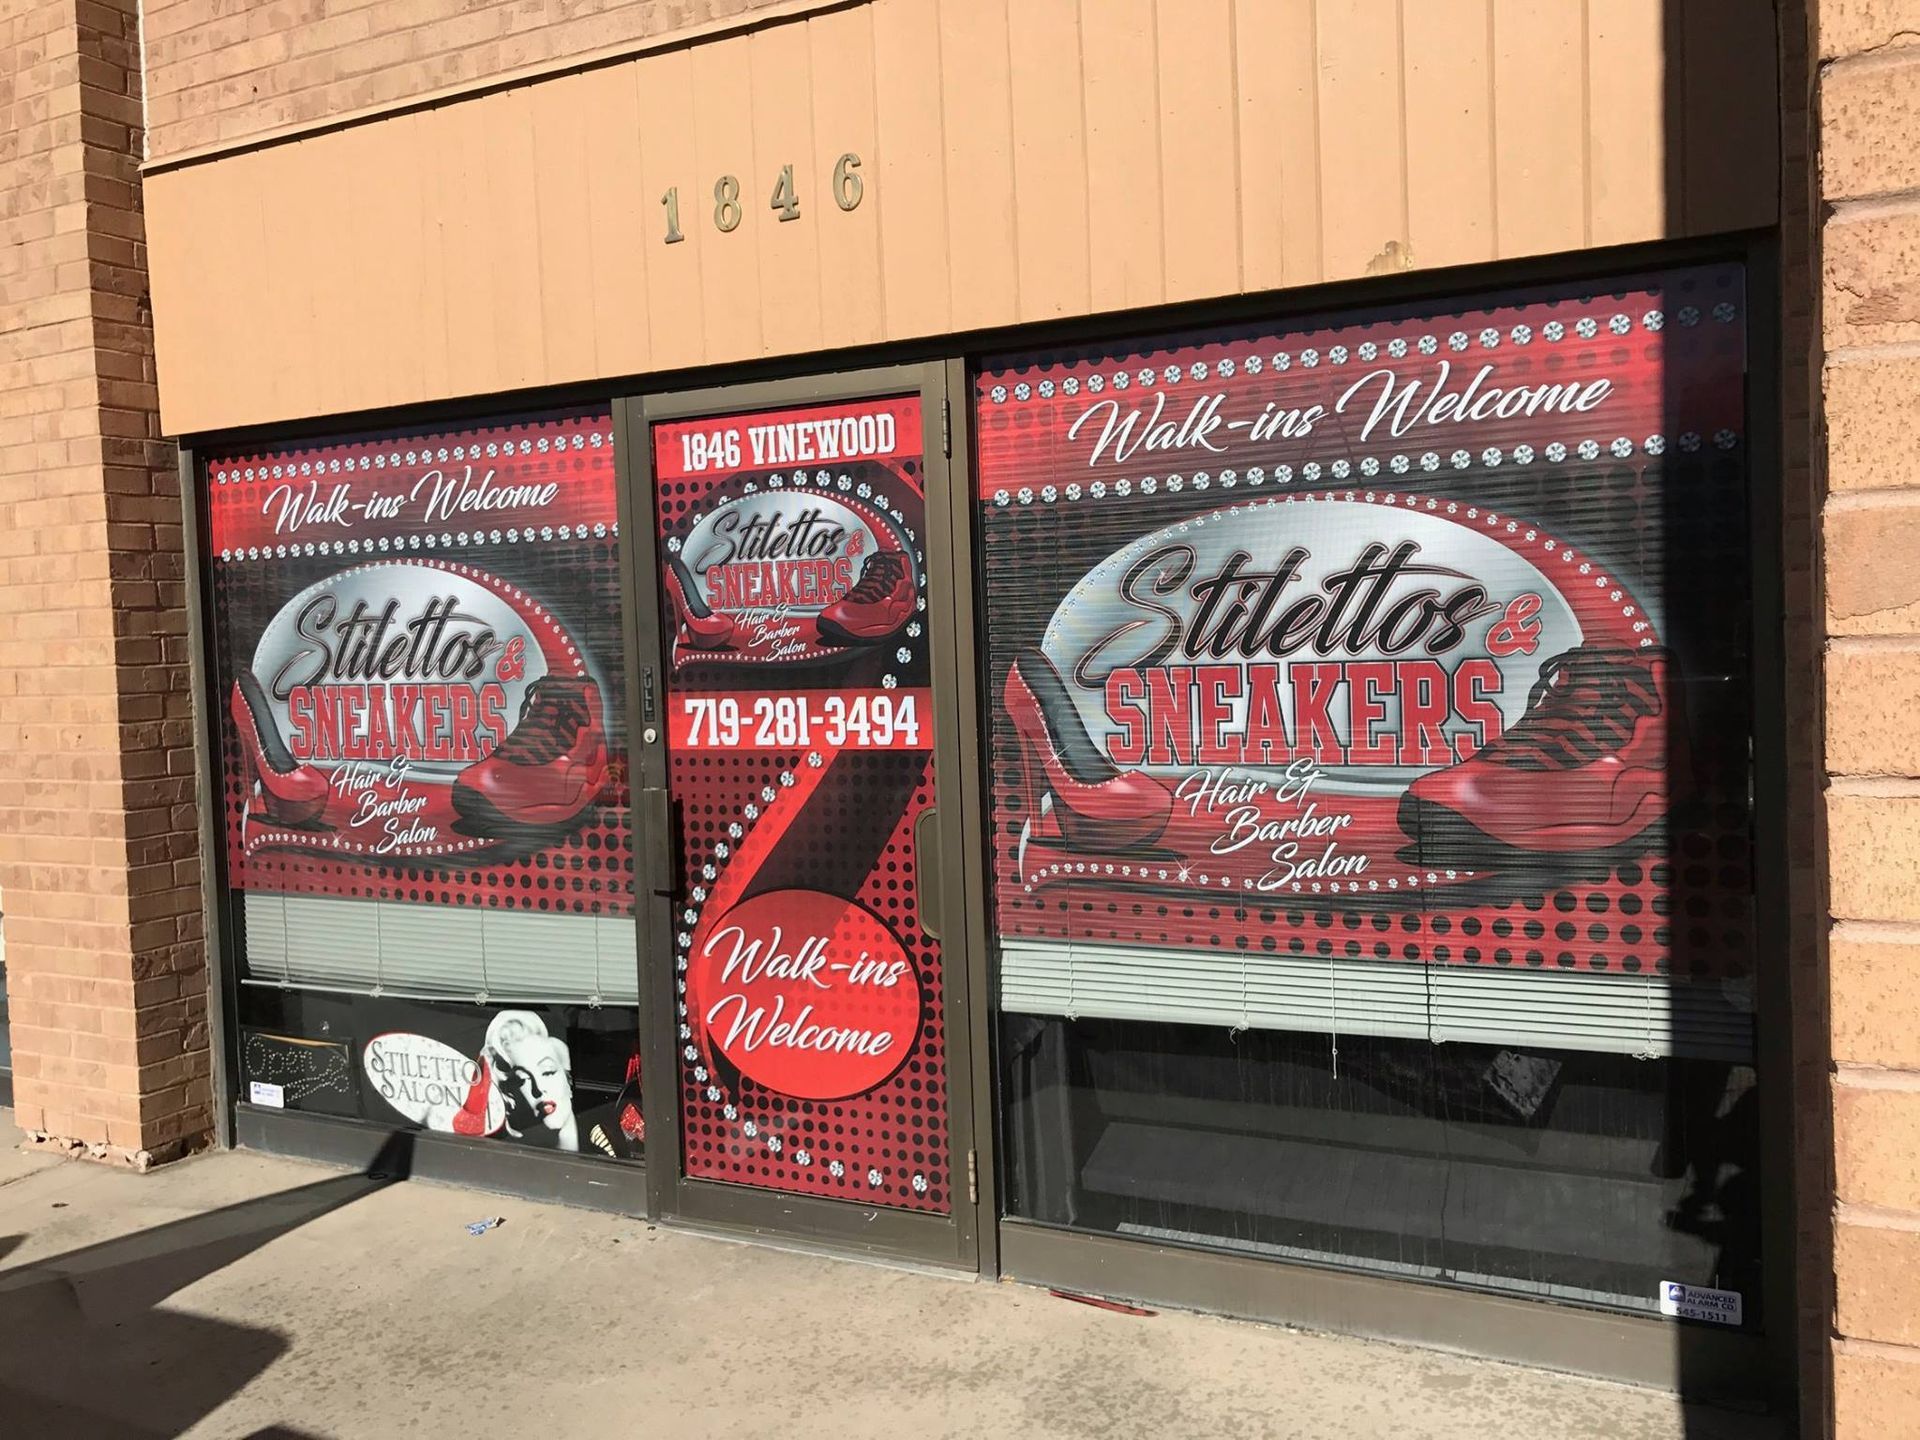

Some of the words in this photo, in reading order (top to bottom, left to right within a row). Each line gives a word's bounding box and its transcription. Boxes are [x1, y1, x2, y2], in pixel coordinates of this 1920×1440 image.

[661, 153, 863, 244] 1846
[1067, 391, 1331, 466] Walk-ins
[1335, 360, 1615, 444] Welcome
[682, 429, 741, 472] 1846
[748, 413, 896, 465] VINEWOOD
[262, 474, 408, 534] Walk-ins
[410, 466, 559, 523] Welcome
[694, 507, 854, 574] Stilettos
[845, 528, 866, 557] &
[705, 557, 854, 609] SNEAKERS
[734, 607, 770, 632] Hair
[748, 624, 801, 647] Barber
[1074, 540, 1505, 692] Stilettos
[1486, 592, 1544, 657] &
[272, 594, 504, 703] Stilettos
[496, 636, 527, 682] &
[766, 640, 808, 662] Salon
[289, 684, 508, 760] SNEAKERS
[685, 695, 919, 747] 719-281-3494
[1104, 658, 1506, 767] SNEAKERS
[330, 761, 382, 799] Hair
[1175, 767, 1269, 817] Hair
[350, 792, 428, 826] Barber
[1210, 805, 1352, 855] Barber
[376, 818, 438, 854] Salon
[1257, 841, 1371, 891] Salon
[704, 926, 911, 988] Walk-ins
[706, 994, 894, 1055] Welcome
[1676, 1307, 1728, 1321] 545-1511
[1687, 1298, 1718, 1308] ALARM
[1688, 1291, 1736, 1304] ADVANCED
